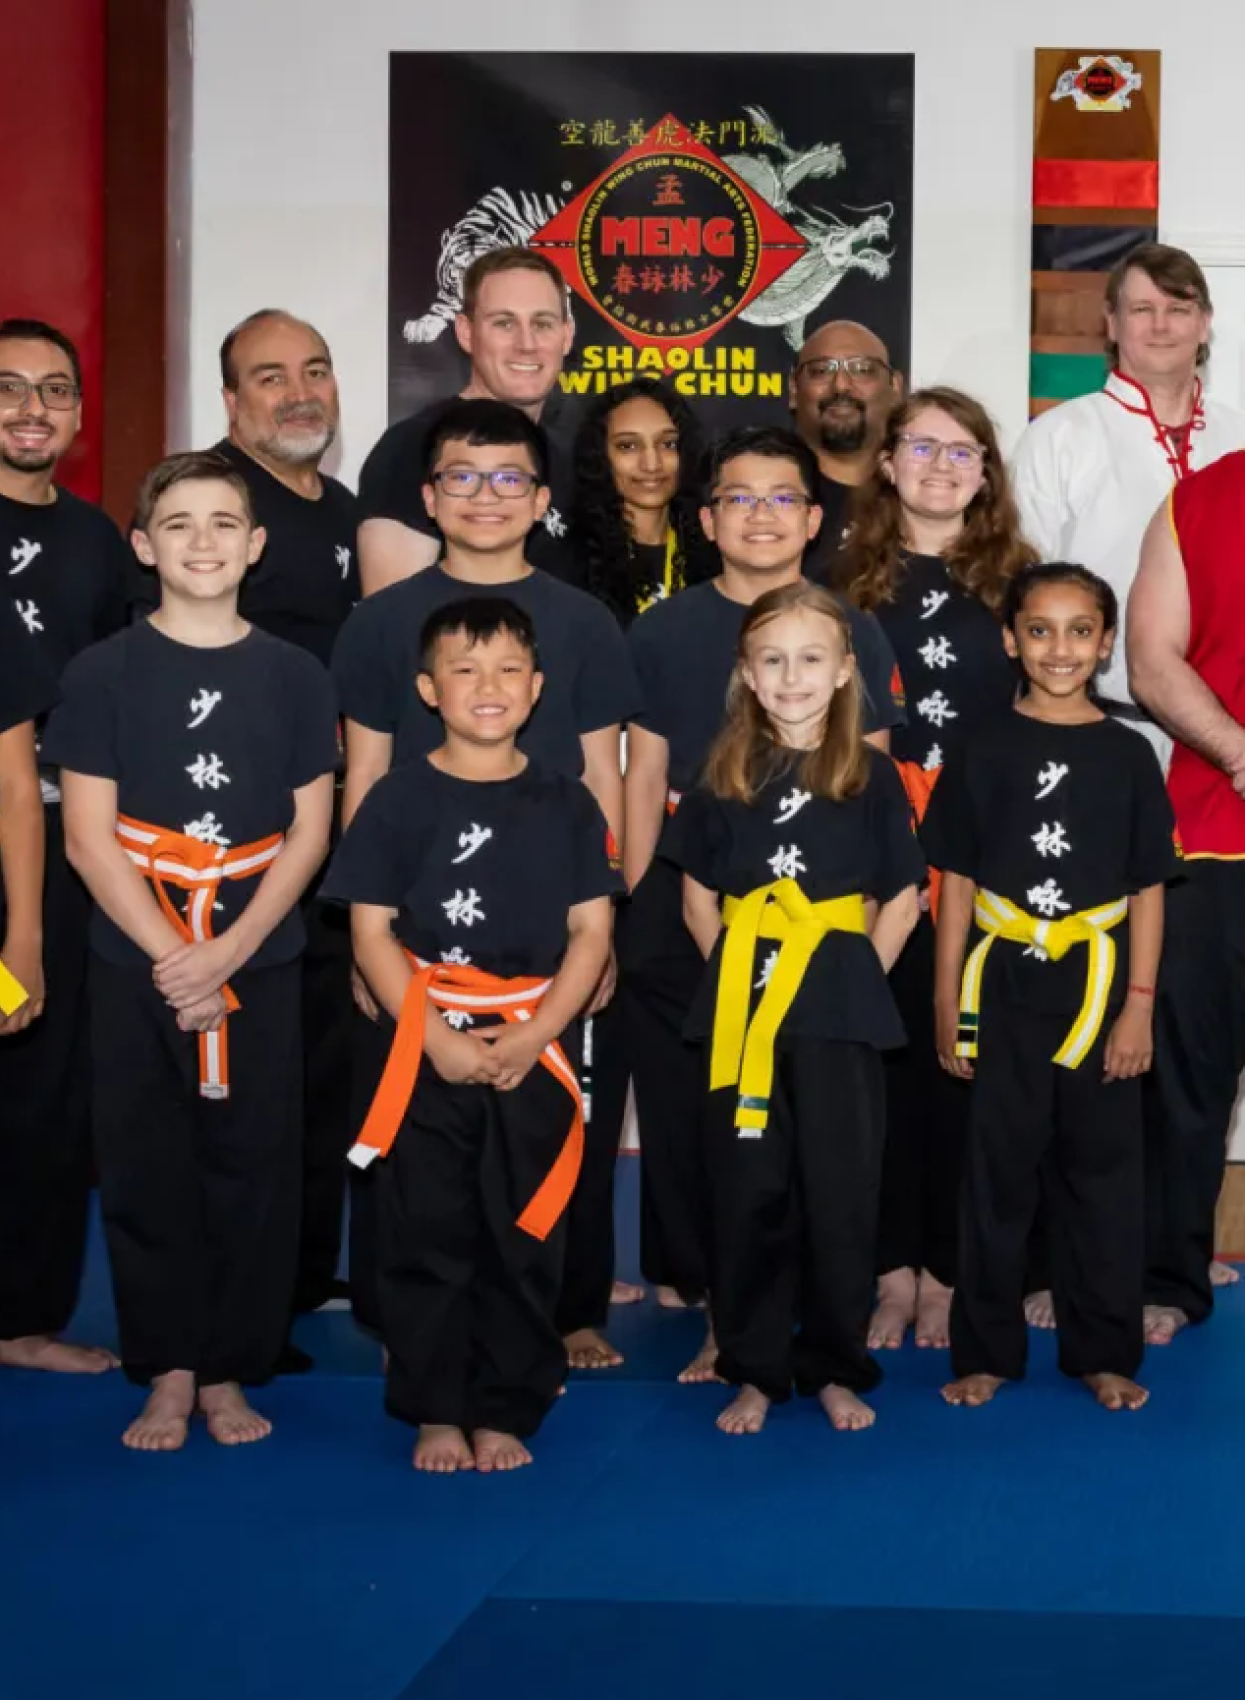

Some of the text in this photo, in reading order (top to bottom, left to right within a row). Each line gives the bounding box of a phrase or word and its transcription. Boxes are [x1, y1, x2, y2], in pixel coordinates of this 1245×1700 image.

[581, 190, 608, 242] SHAOLIN
[606, 165, 635, 191] WING
[635, 156, 670, 172] CHUN
[673, 157, 722, 186] MARTIAL
[722, 179, 748, 212] ARTS
[736, 211, 758, 288] FEDERATION
[601, 216, 734, 257] MENG
[583, 345, 756, 370] SHAOLIN
[558, 370, 782, 397] WIN CHUN
